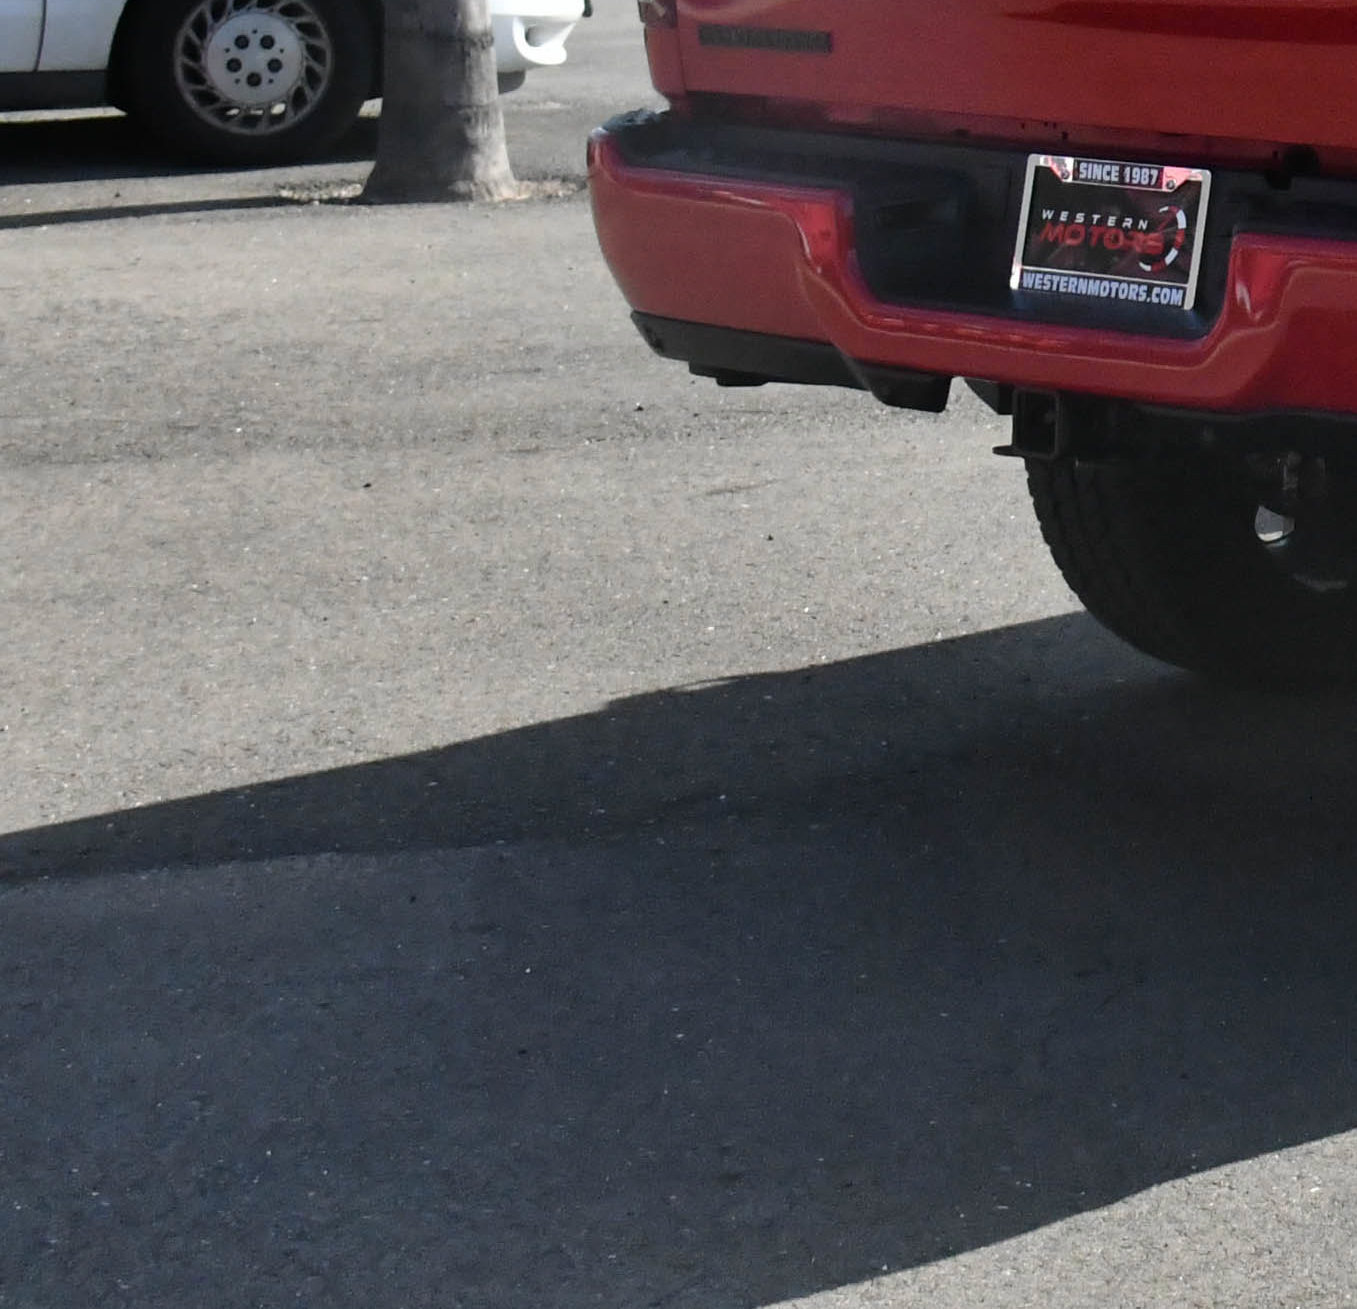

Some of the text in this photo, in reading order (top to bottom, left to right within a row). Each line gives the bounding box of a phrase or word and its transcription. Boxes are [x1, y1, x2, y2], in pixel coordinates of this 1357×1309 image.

[1078, 162, 1160, 185] SINCE 1987
[1042, 209, 1149, 230] WESTERN
[1039, 223, 1165, 255] MOTORS
[1022, 274, 1184, 306] WESTERNMOTORS.COM
